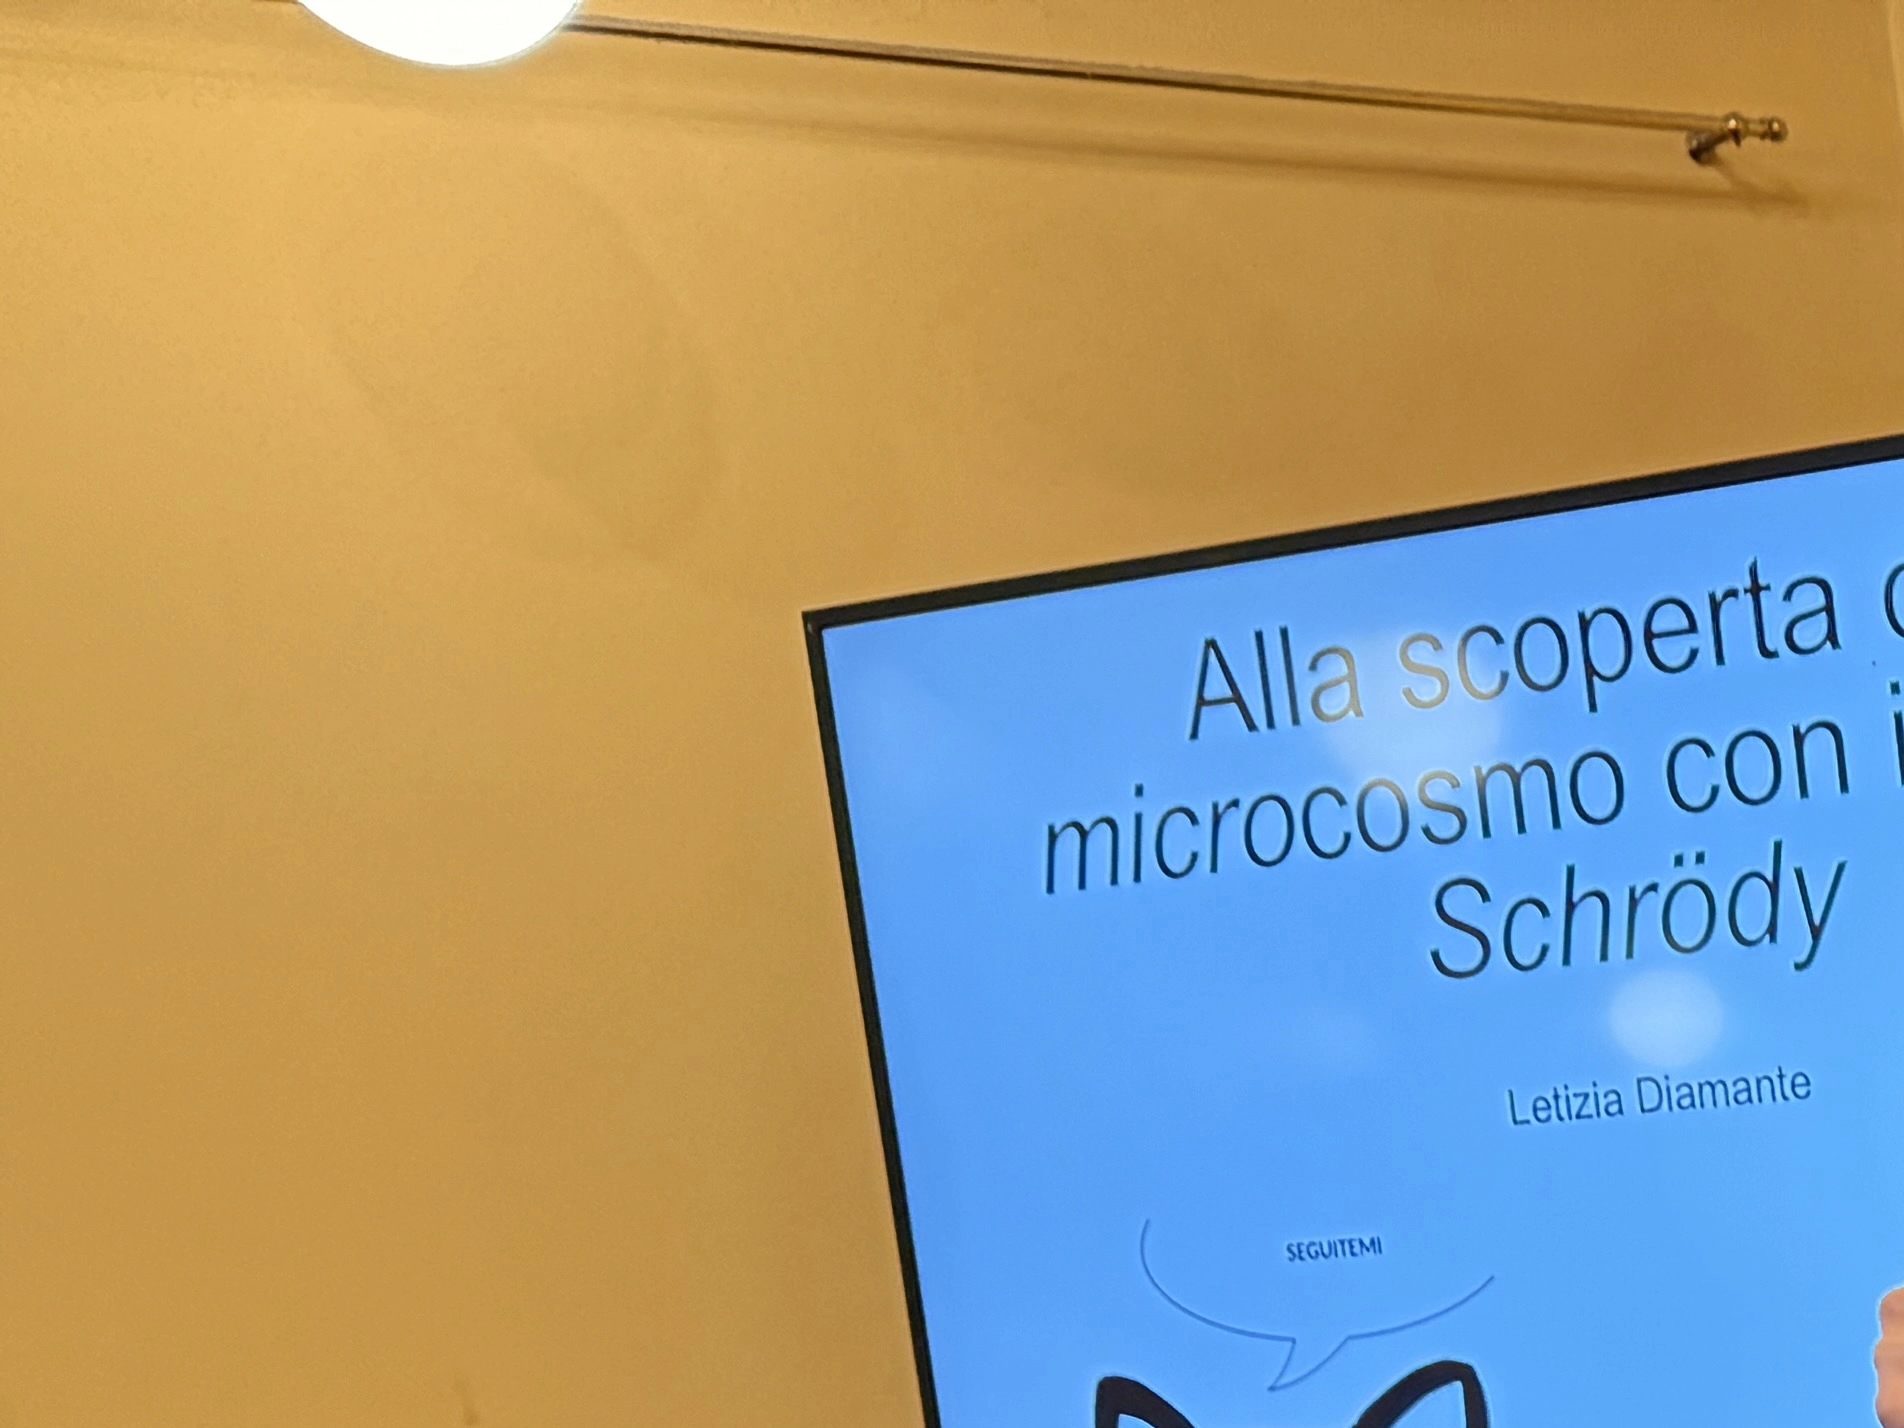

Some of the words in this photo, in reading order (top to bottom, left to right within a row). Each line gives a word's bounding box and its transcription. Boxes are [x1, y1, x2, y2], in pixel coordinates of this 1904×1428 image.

[1189, 626, 1364, 741] Alla
[1400, 556, 1842, 713] scoperta
[1046, 747, 1626, 894] microcosmo
[1665, 718, 1850, 814] con
[1430, 840, 1847, 980] Schrödy
[1508, 1083, 1624, 1126] Letizia
[1636, 1066, 1812, 1114] Diamante
[1286, 1235, 1383, 1262] SEGUITEMI
